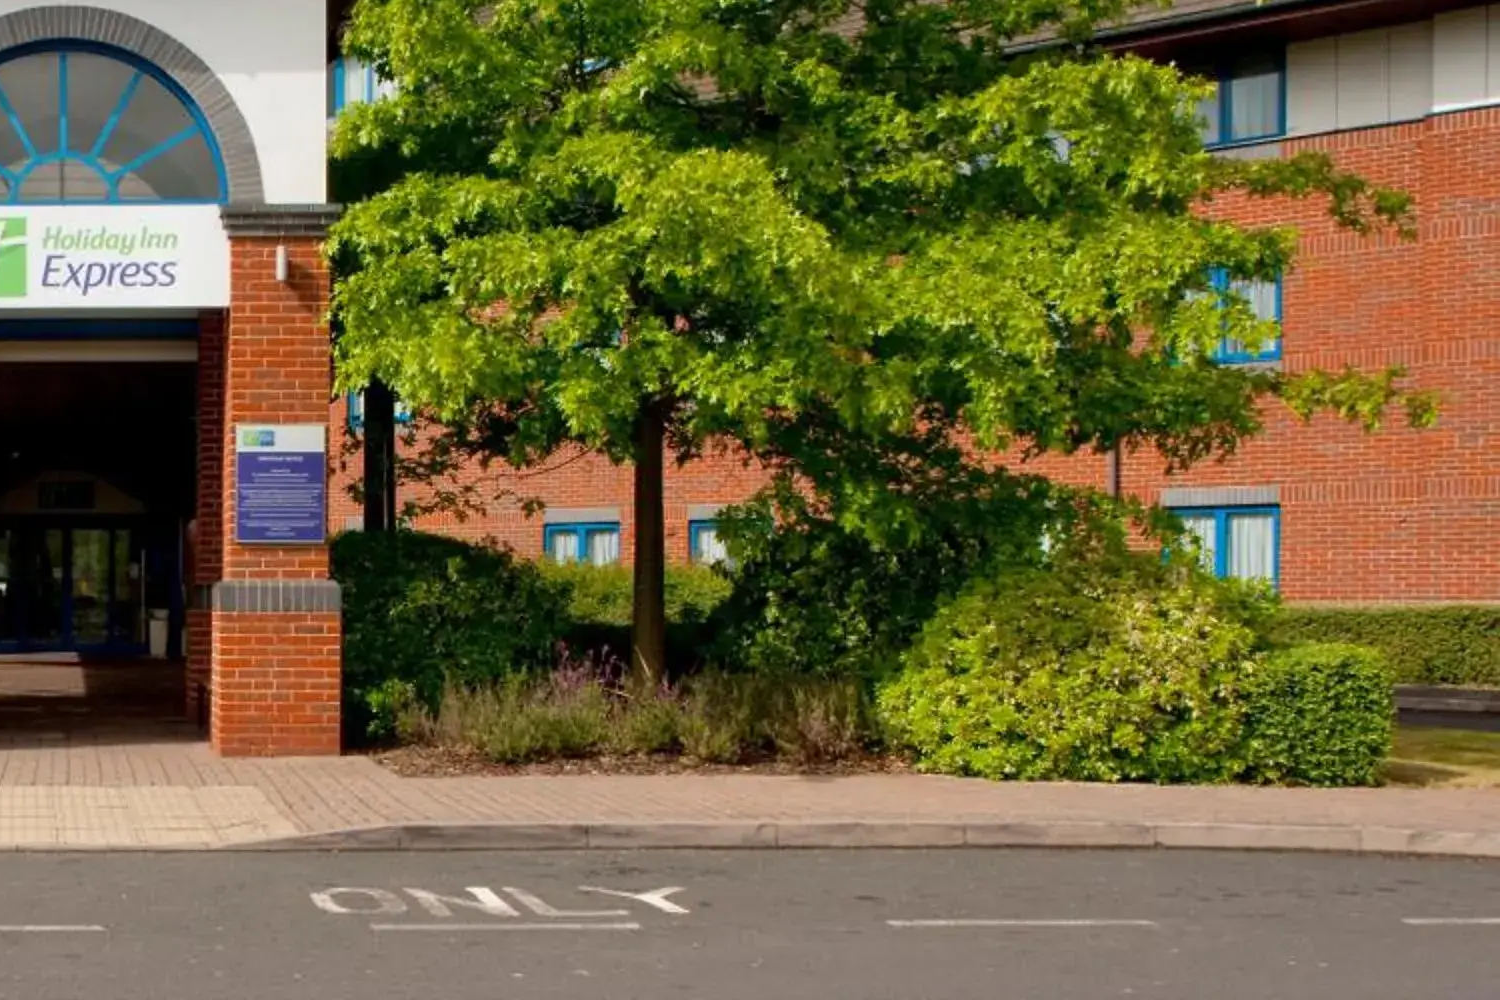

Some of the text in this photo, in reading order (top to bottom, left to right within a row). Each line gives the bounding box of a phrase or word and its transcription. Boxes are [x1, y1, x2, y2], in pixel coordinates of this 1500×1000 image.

[42, 226, 179, 254] Holiday Inn
[41, 254, 178, 295] Express
[309, 885, 691, 917] ONLY
